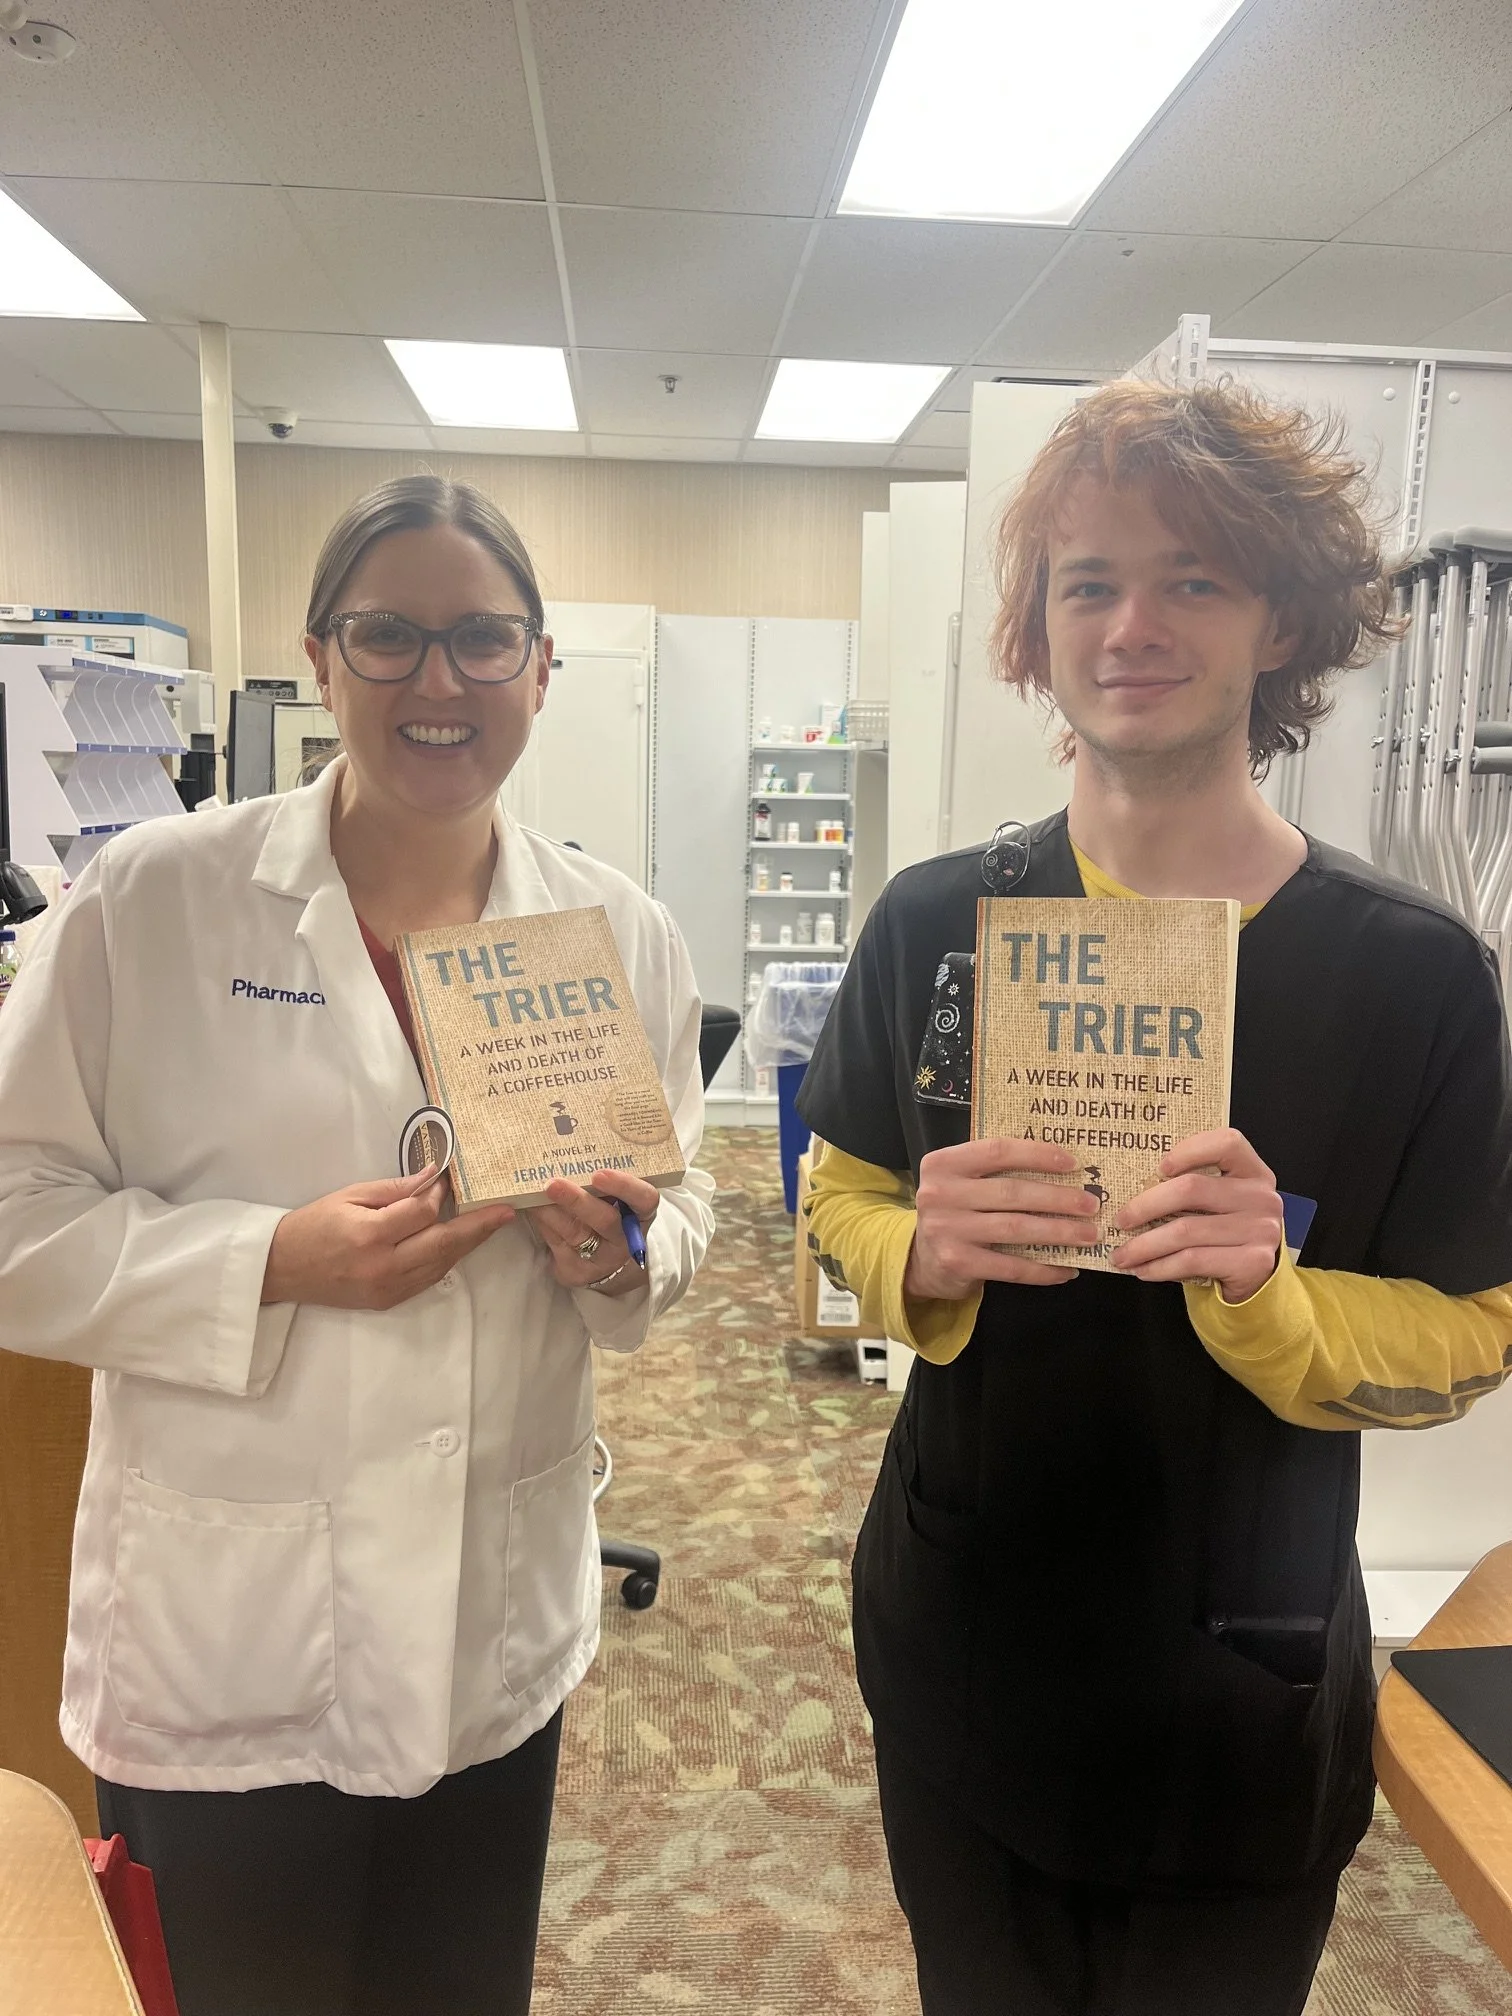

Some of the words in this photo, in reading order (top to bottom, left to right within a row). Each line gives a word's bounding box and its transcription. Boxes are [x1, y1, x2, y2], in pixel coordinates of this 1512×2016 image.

[425, 941, 525, 987] THE
[1001, 932, 1107, 986] THE
[473, 976, 621, 1028] TRIER
[460, 1045, 472, 1059] A
[475, 1036, 526, 1055] WEEK
[530, 1033, 548, 1047] IN
[551, 1028, 584, 1044] THE
[588, 1023, 621, 1039] LIFE
[1038, 1000, 1204, 1060] TRIER
[488, 1058, 522, 1075] AND
[527, 1050, 580, 1069] DEATH
[585, 1045, 604, 1060] OF
[487, 1084, 499, 1097] A
[503, 1065, 618, 1094] COFFEEHOUSE
[1007, 1067, 1019, 1085] A
[1026, 1068, 1080, 1088] WEEK
[1086, 1072, 1105, 1090] IN
[1111, 1073, 1149, 1093] THE
[1155, 1075, 1194, 1096] LIFE
[1029, 1097, 1069, 1117] AND
[1075, 1100, 1136, 1121] DEATH
[1143, 1104, 1167, 1123] OF
[542, 1150, 549, 1160] A
[551, 1145, 583, 1159] NOVEL
[584, 1143, 597, 1154] BY
[1023, 1125, 1036, 1142] A
[1042, 1126, 1173, 1152] COFFEEHOUSE
[513, 1164, 556, 1183] JERRY
[559, 1154, 636, 1177] VANSCHAIK
[1107, 1226, 1121, 1237] BY
[1076, 1243, 1120, 1259] VANS
